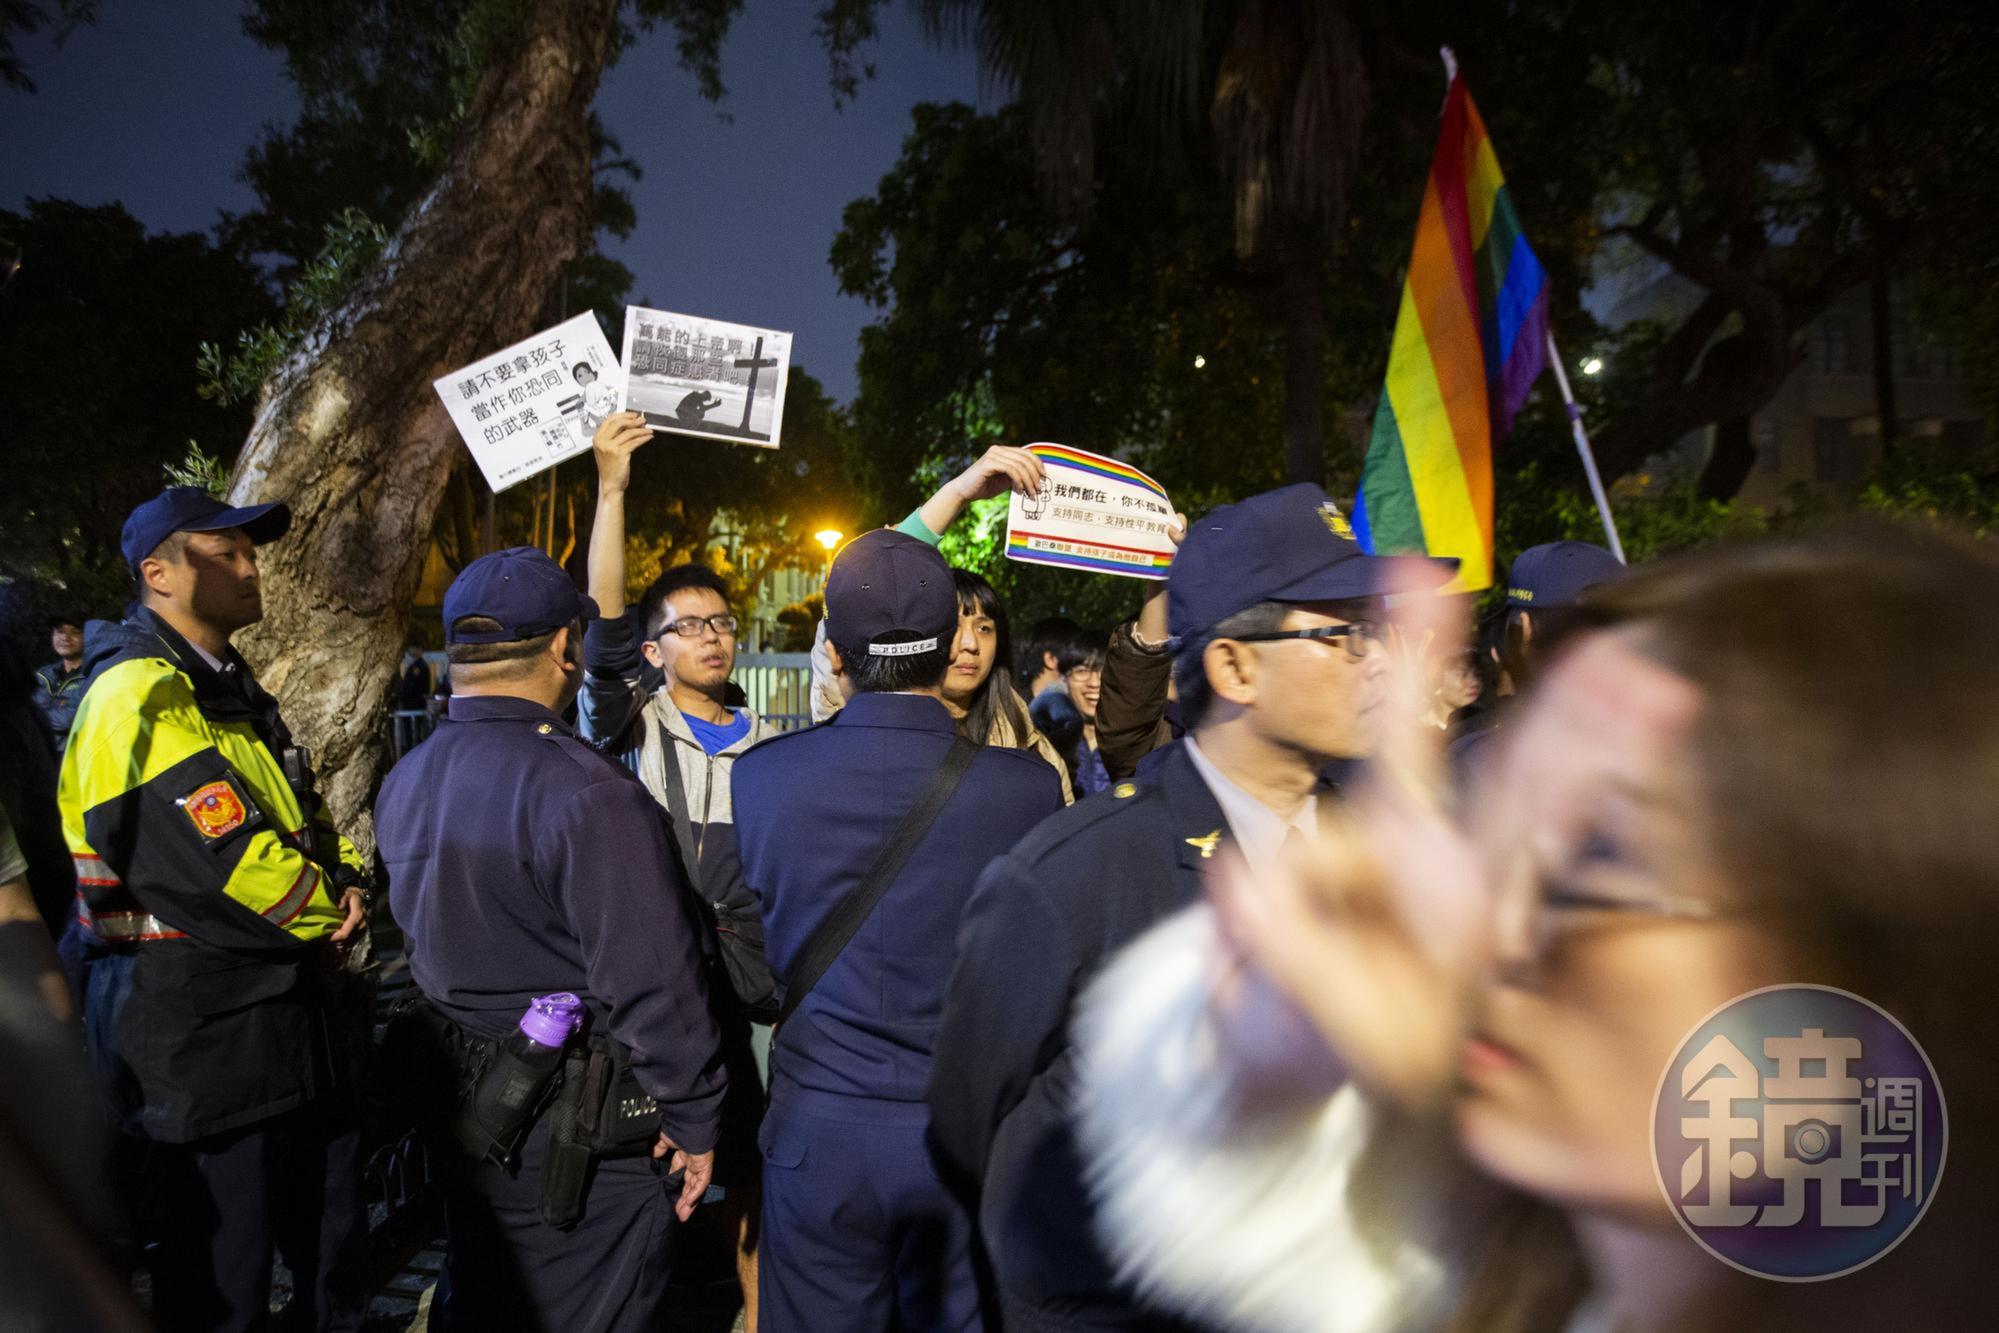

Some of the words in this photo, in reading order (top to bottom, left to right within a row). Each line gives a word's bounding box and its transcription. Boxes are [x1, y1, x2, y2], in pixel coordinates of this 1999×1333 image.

[457, 339, 567, 400] 請不要拿孩子
[471, 369, 563, 422] 當作你恐同
[483, 407, 540, 445] 的武器
[882, 644, 925, 655] POLICE
[620, 1096, 657, 1119] POLICE
